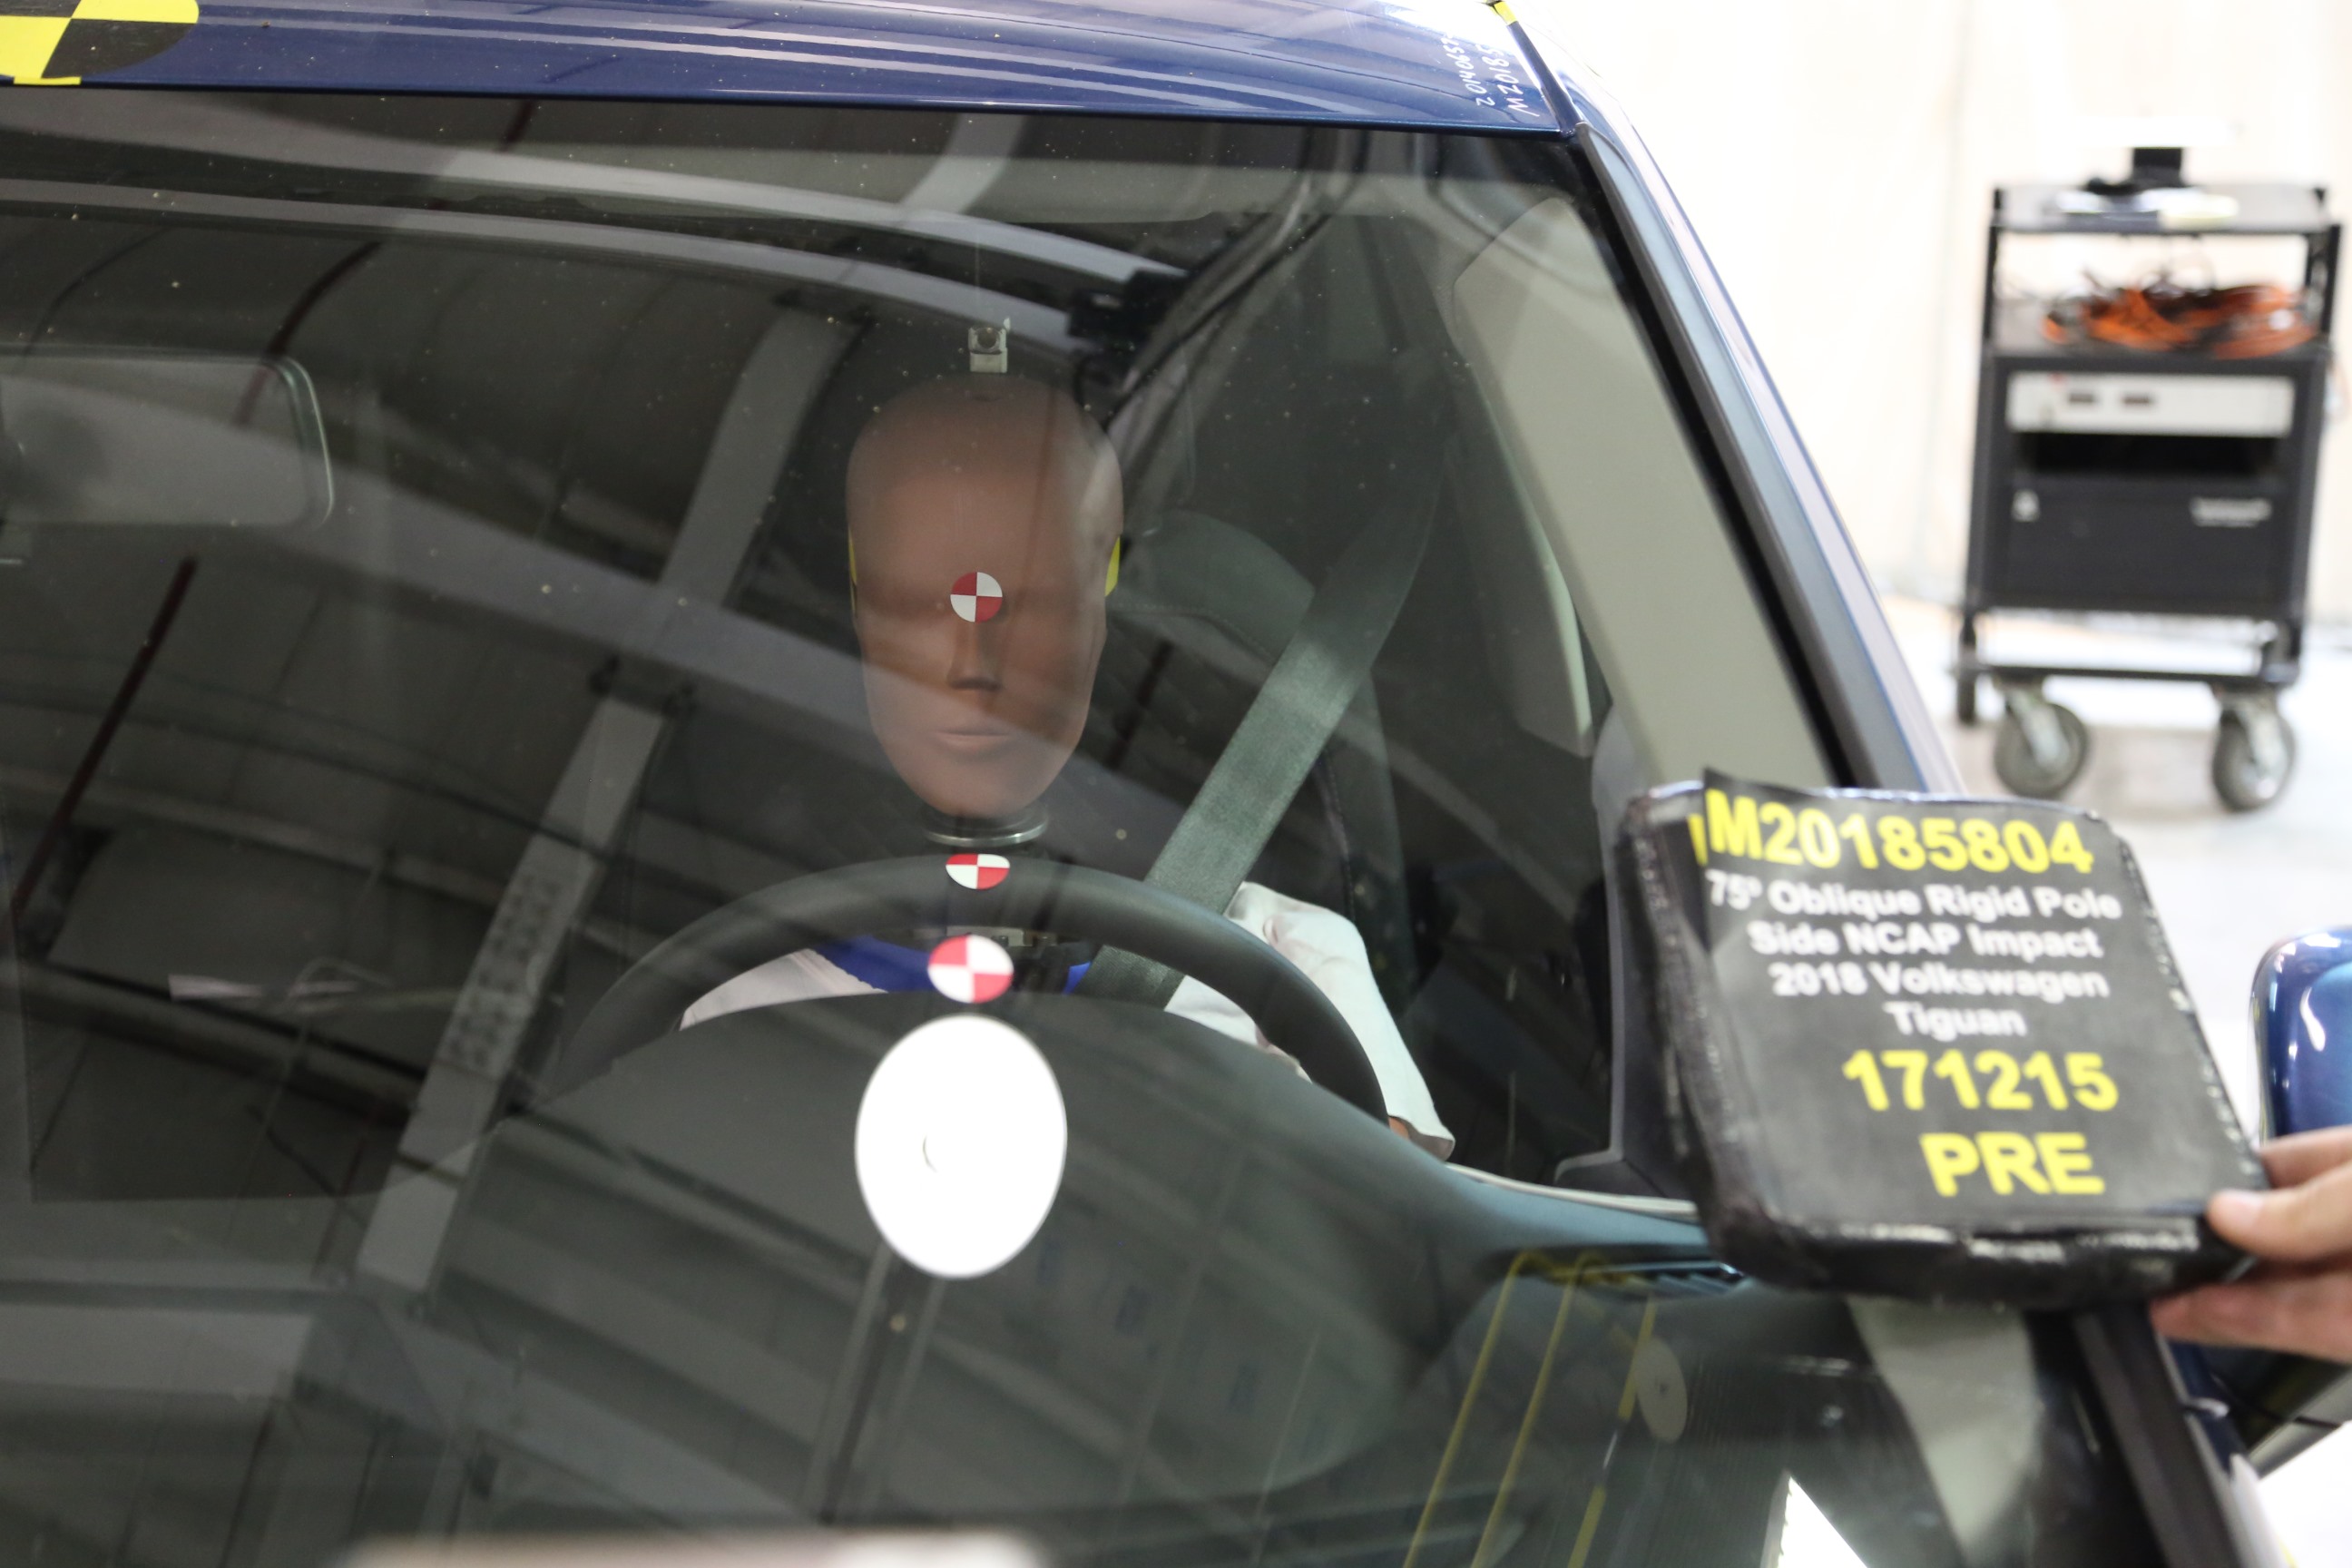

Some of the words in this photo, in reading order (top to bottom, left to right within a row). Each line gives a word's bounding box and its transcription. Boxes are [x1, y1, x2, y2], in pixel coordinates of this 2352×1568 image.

[1705, 788, 2094, 874] M20185804
[1768, 879, 1922, 921] Oblique
[1924, 884, 2032, 923] Rigid
[2032, 886, 2122, 919] Pole
[1746, 920, 1840, 955] Side
[1842, 921, 1962, 955] NCAP
[1965, 923, 2104, 964] Impact
[1768, 961, 1868, 996] 2018
[1866, 960, 2111, 1004] Volkswagen
[1881, 1000, 2028, 1042] Tiguan
[1843, 1049, 2119, 1112] 171215
[1920, 1131, 2105, 1198] PRE
